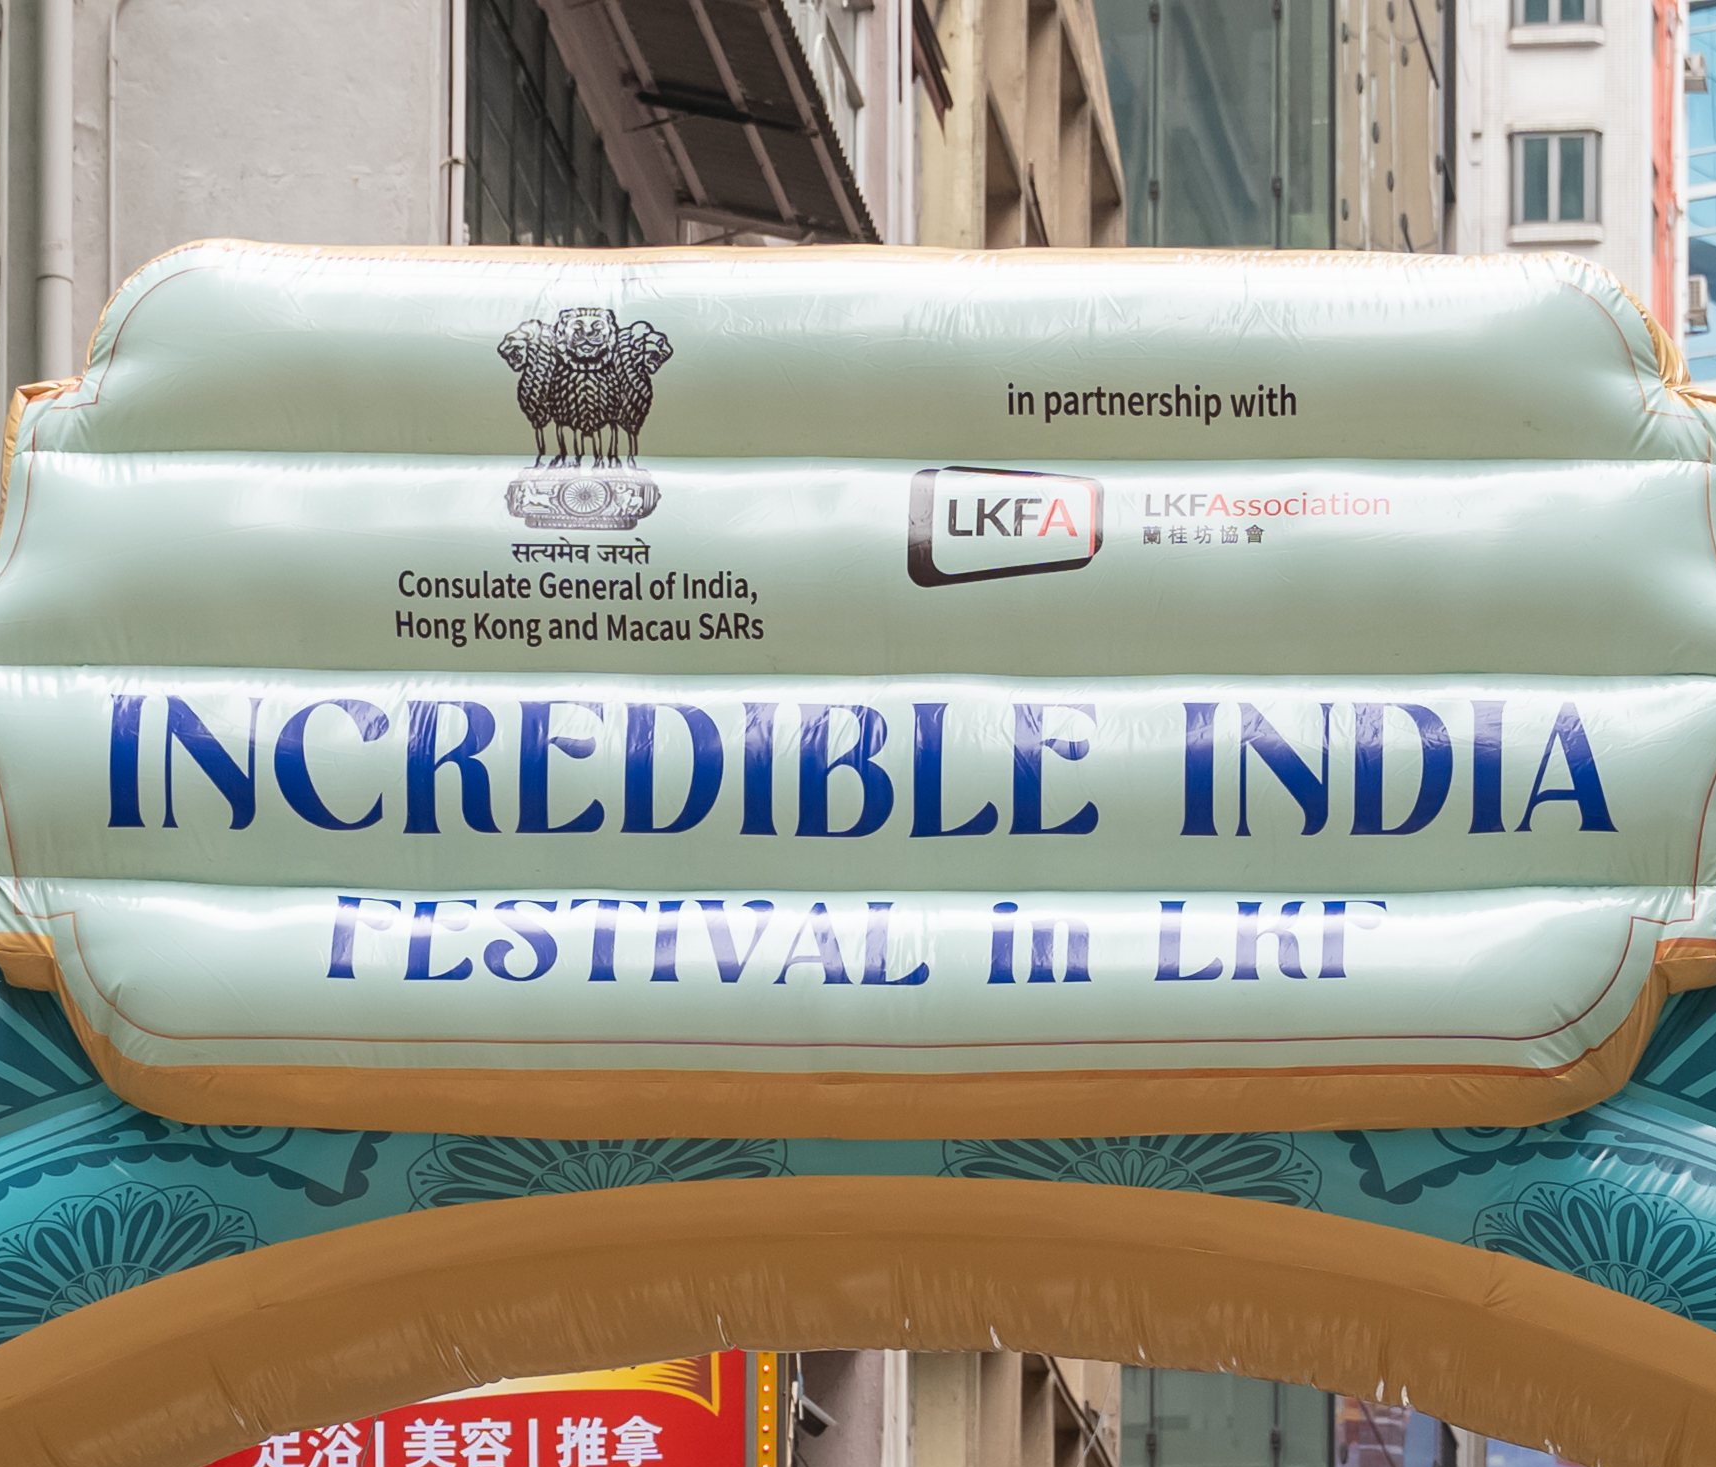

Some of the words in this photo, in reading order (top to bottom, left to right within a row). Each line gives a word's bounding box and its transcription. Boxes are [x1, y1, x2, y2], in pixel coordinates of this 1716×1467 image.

[1007, 385, 1033, 416] in
[1043, 383, 1222, 423] partnership
[1230, 384, 1297, 417] with
[946, 496, 1079, 540] LKFA
[1143, 490, 1391, 520] LKFAssociation
[512, 538, 591, 565] सत्यमेव
[598, 538, 650, 566] जयते
[1142, 525, 1266, 547] 蘭桂坊協會
[397, 569, 531, 604] Consulate
[539, 570, 643, 603] General
[649, 571, 676, 602] of
[682, 571, 758, 607] India,
[395, 610, 466, 648] Hong
[474, 611, 541, 648] Kong
[548, 612, 598, 643] and
[605, 615, 690, 644] Macau
[698, 614, 765, 643] SARs
[108, 691, 1101, 840] INCREDIBLE
[1178, 696, 1620, 836] INDIA
[325, 893, 933, 986] FESTIVAL
[985, 900, 1093, 984] in
[1157, 898, 1389, 982] LKF
[556, 1415, 664, 1467] 推拿
